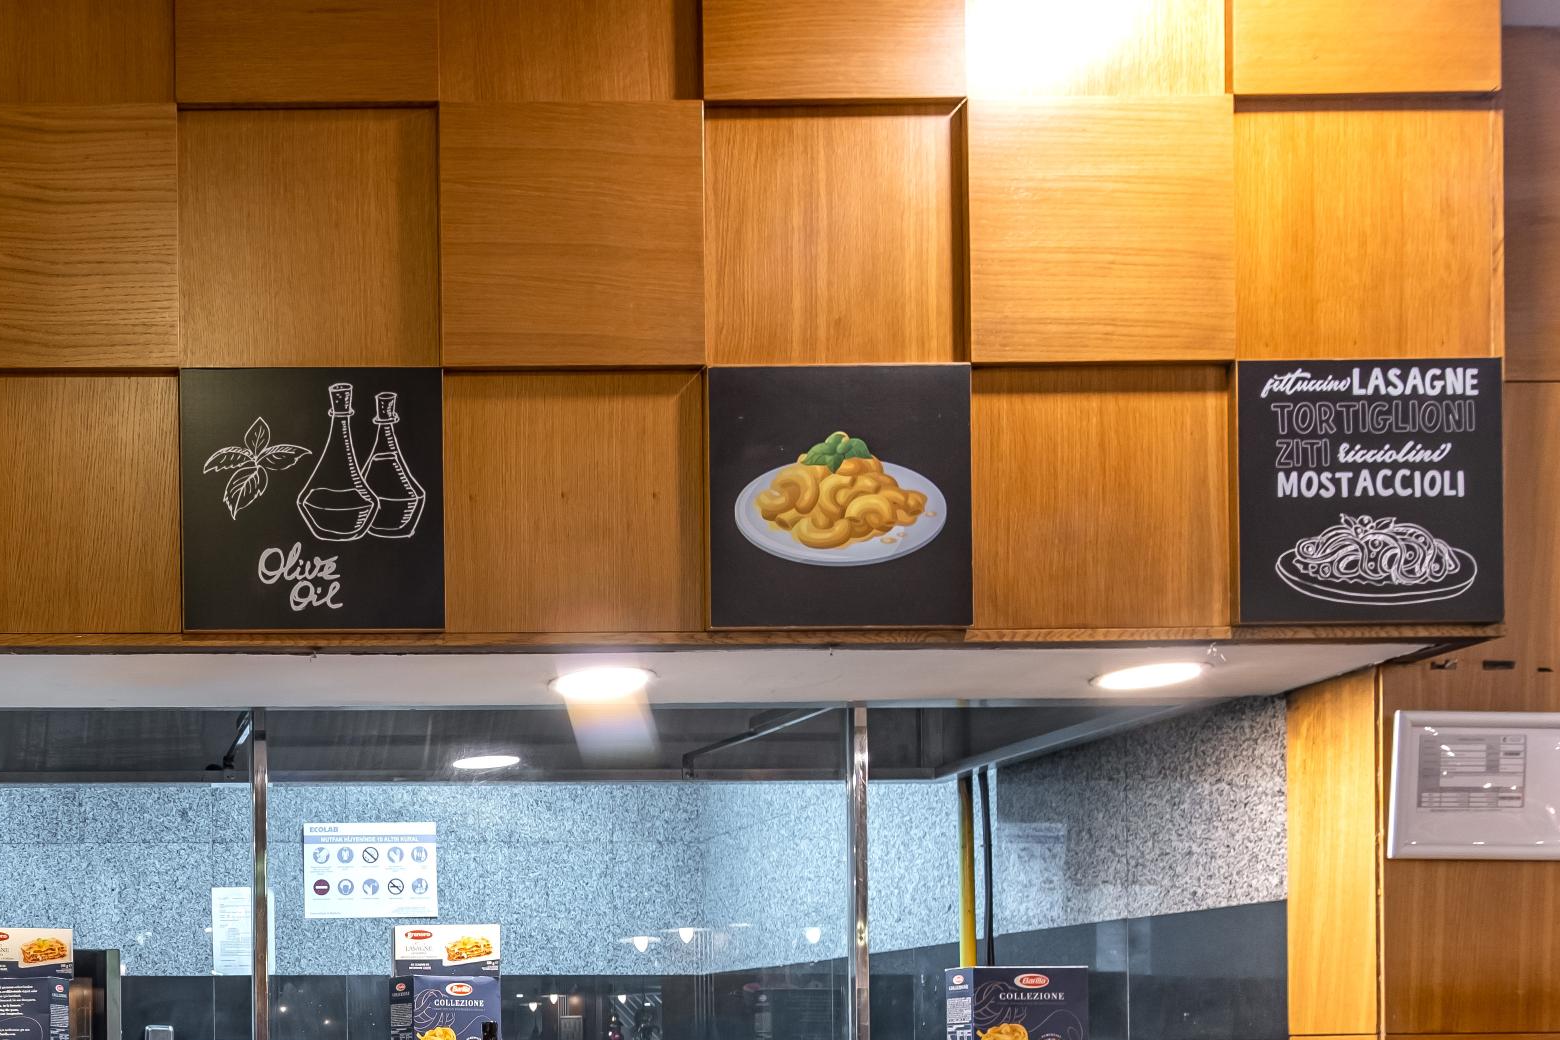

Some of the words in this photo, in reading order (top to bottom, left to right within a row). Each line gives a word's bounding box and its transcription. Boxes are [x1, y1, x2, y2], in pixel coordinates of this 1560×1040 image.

[1352, 367, 1479, 396] LASAGNE
[1271, 400, 1476, 434] TORTIGLIONI
[1275, 438, 1330, 468] ZITI
[1277, 469, 1465, 498] MOSTACCIOLI
[258, 541, 340, 585] Olive
[290, 580, 343, 612] Oil
[434, 999, 484, 1007] COLLEZIONE
[999, 992, 1065, 1000] COLLEZIONE
